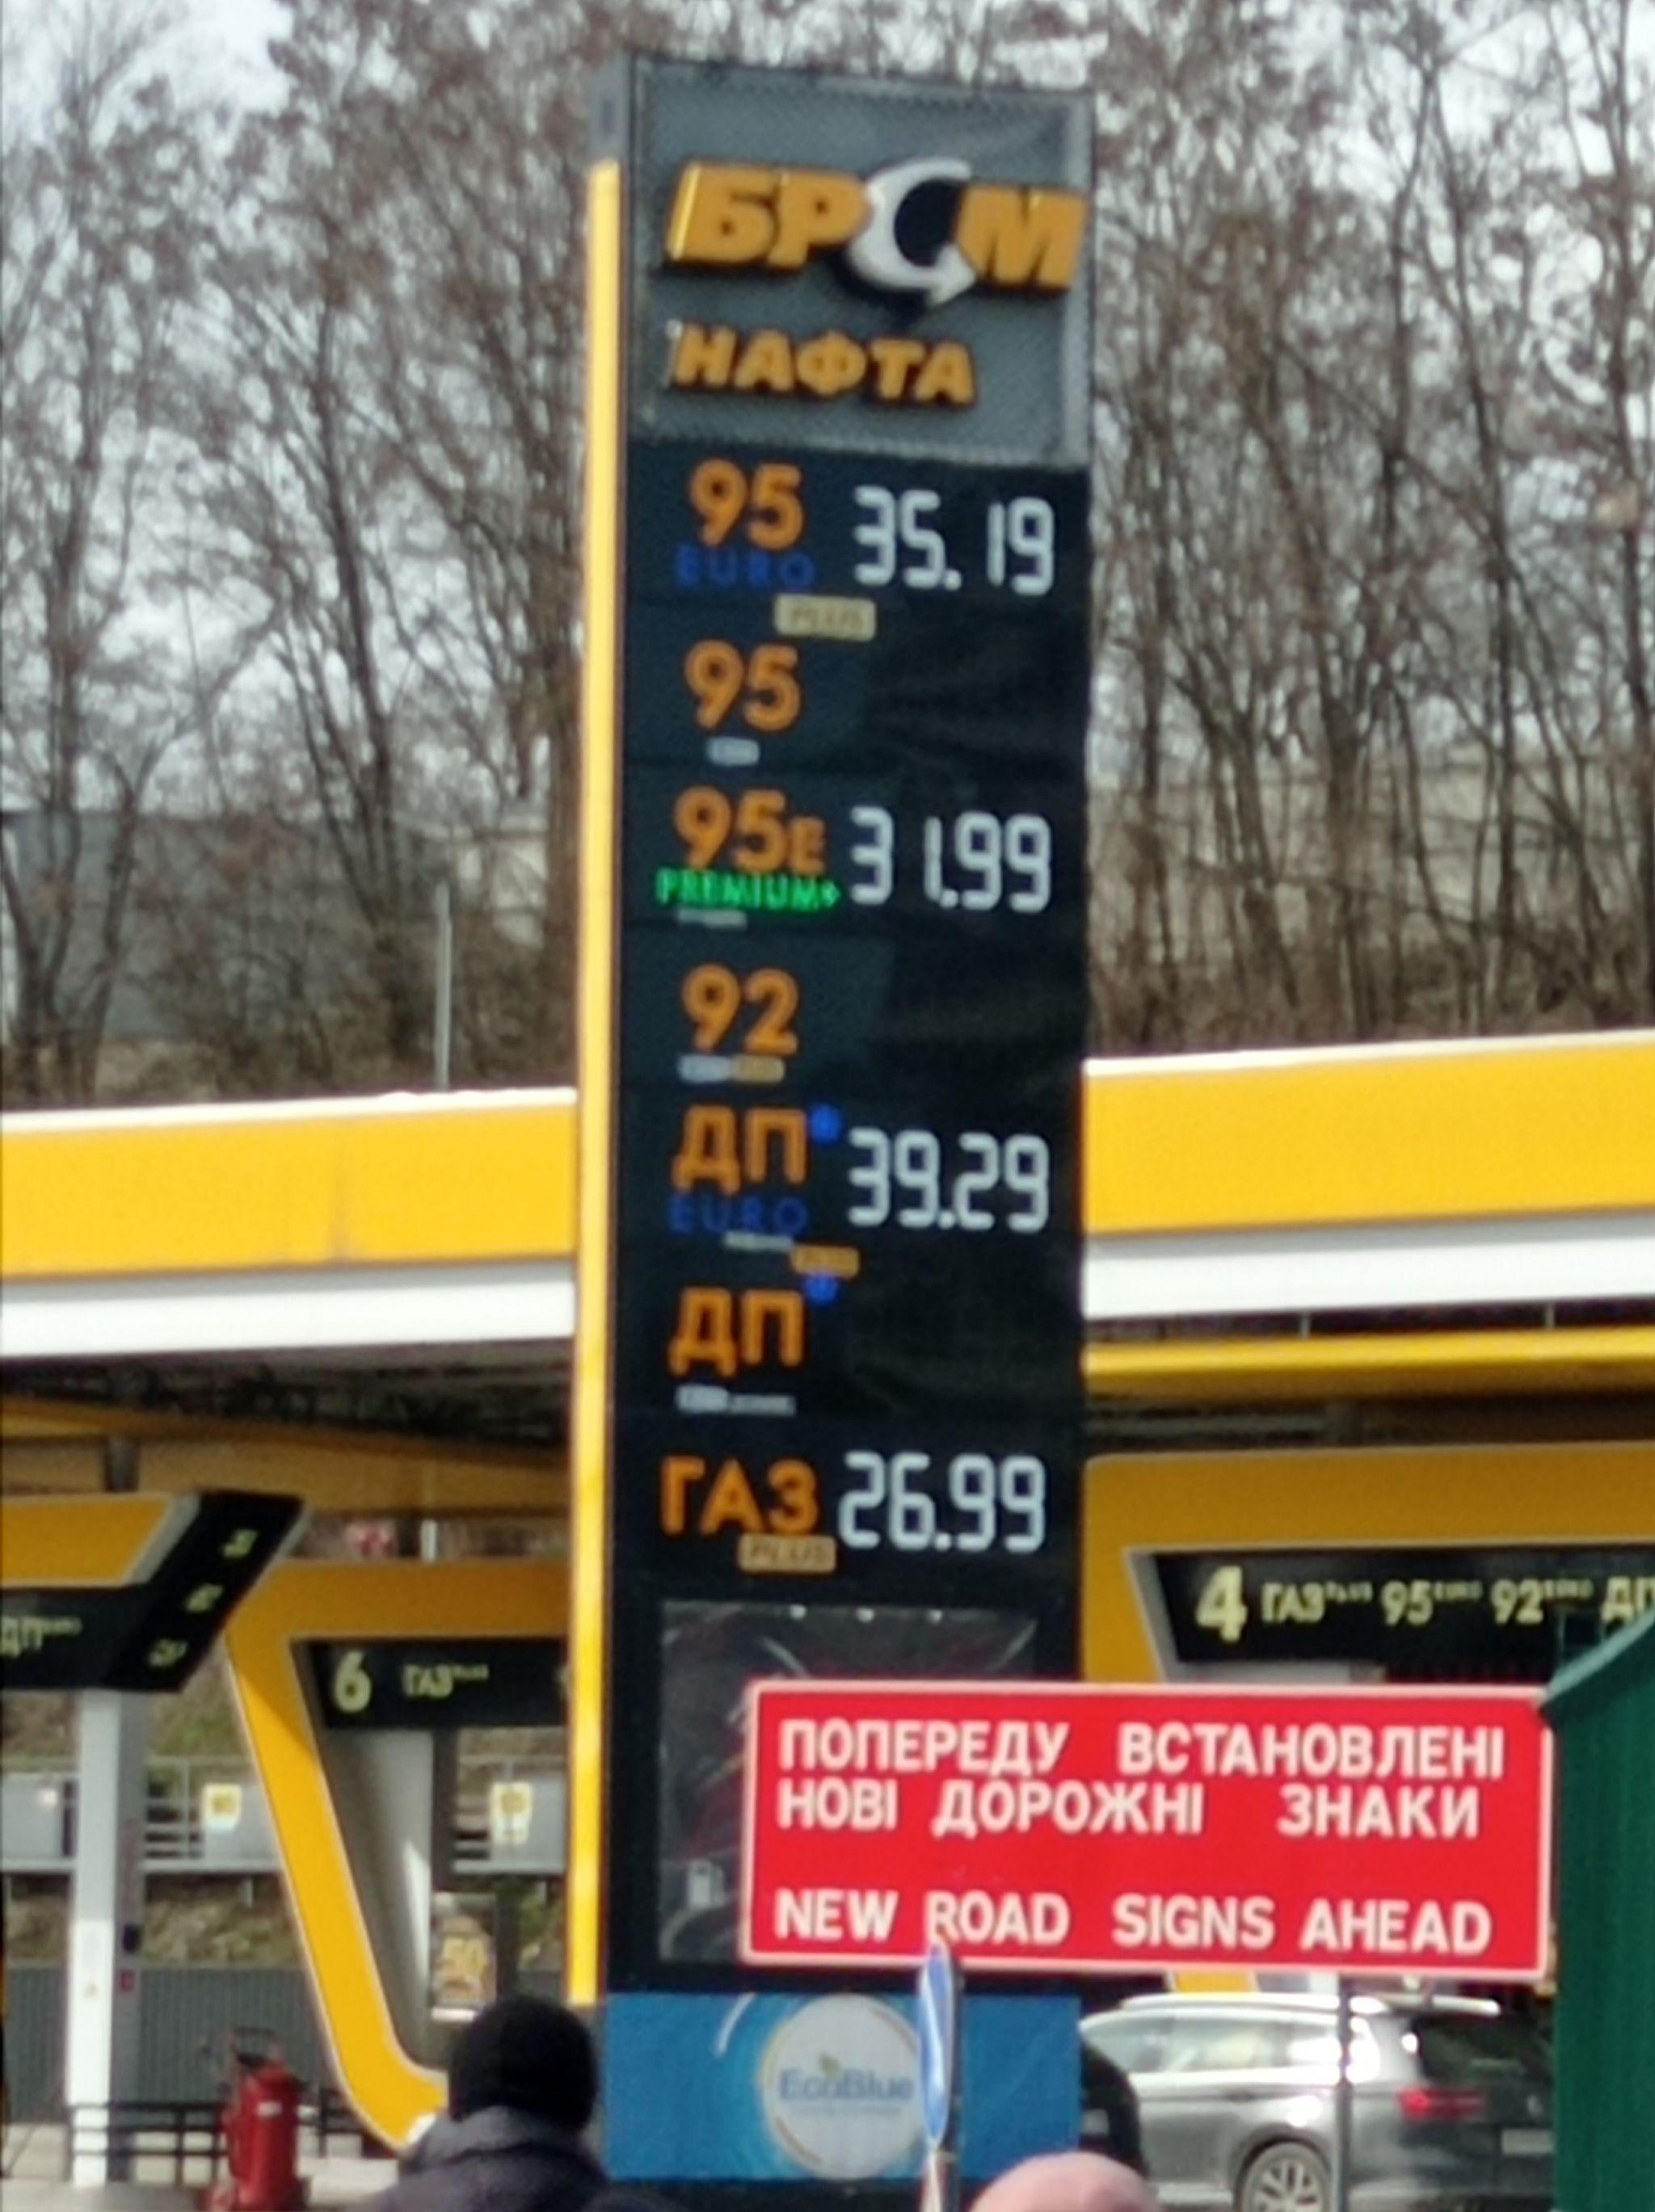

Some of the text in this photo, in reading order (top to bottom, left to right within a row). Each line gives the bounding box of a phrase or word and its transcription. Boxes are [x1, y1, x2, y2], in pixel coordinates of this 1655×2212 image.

[666, 320, 976, 406] НАФТА
[675, 543, 816, 590] EURO
[689, 458, 1055, 598] 95 35.19
[684, 639, 802, 731] 95
[850, 805, 1052, 913] 31.99
[681, 964, 800, 1056] 92
[671, 1104, 1050, 1234] ДП 39.29
[667, 1195, 809, 1236] EURO
[668, 1285, 804, 1377] ДП
[660, 1450, 1046, 1554] ГАЗ 26.99
[1194, 1564, 1249, 1644] 4
[1380, 1579, 1434, 1627] 95
[1491, 1579, 1544, 1627] 92
[334, 1650, 373, 1713] 6
[779, 1718, 1506, 1781] ПОПЕРЕДУ ВСТАНОВЛЕНІ
[777, 1777, 1480, 1839] НОВІ ДОРОЖНІ ЗНАКИ
[773, 1886, 1493, 1955] NEW ROAD SIGNS AHEAD
[779, 2068, 916, 2101] EcoBlue
